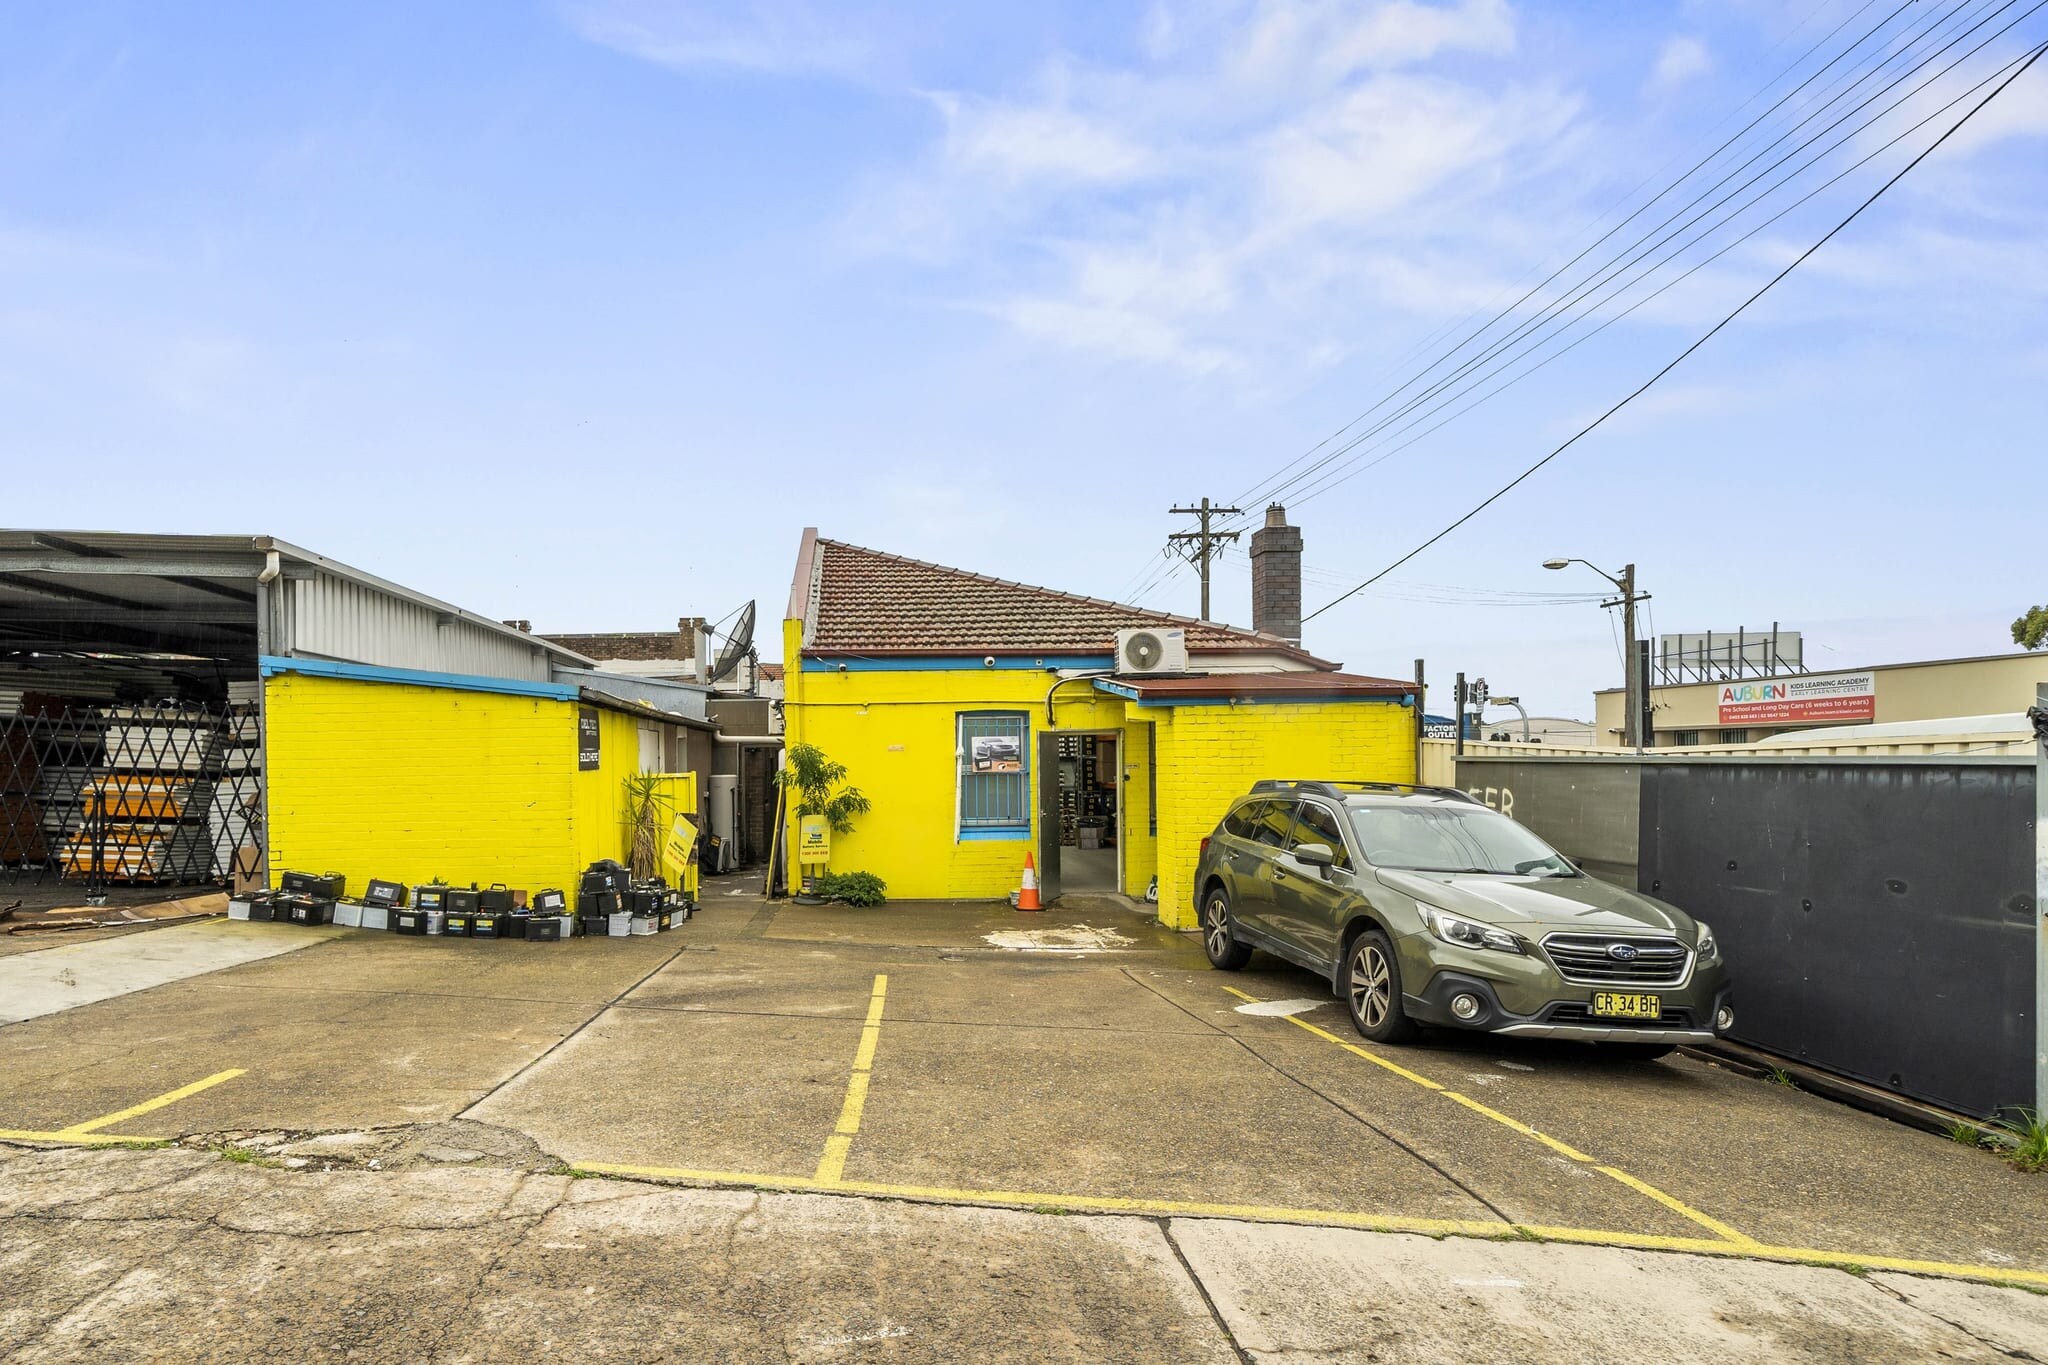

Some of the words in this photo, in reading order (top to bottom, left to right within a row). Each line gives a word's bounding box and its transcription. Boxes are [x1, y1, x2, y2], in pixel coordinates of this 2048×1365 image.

[1790, 682, 1804, 690] KIDS
[1805, 680, 1836, 688] LEARNING
[1837, 677, 1870, 686] ACADEMY
[1723, 683, 1786, 702] AUBURN
[1848, 699, 1870, 707] years)
